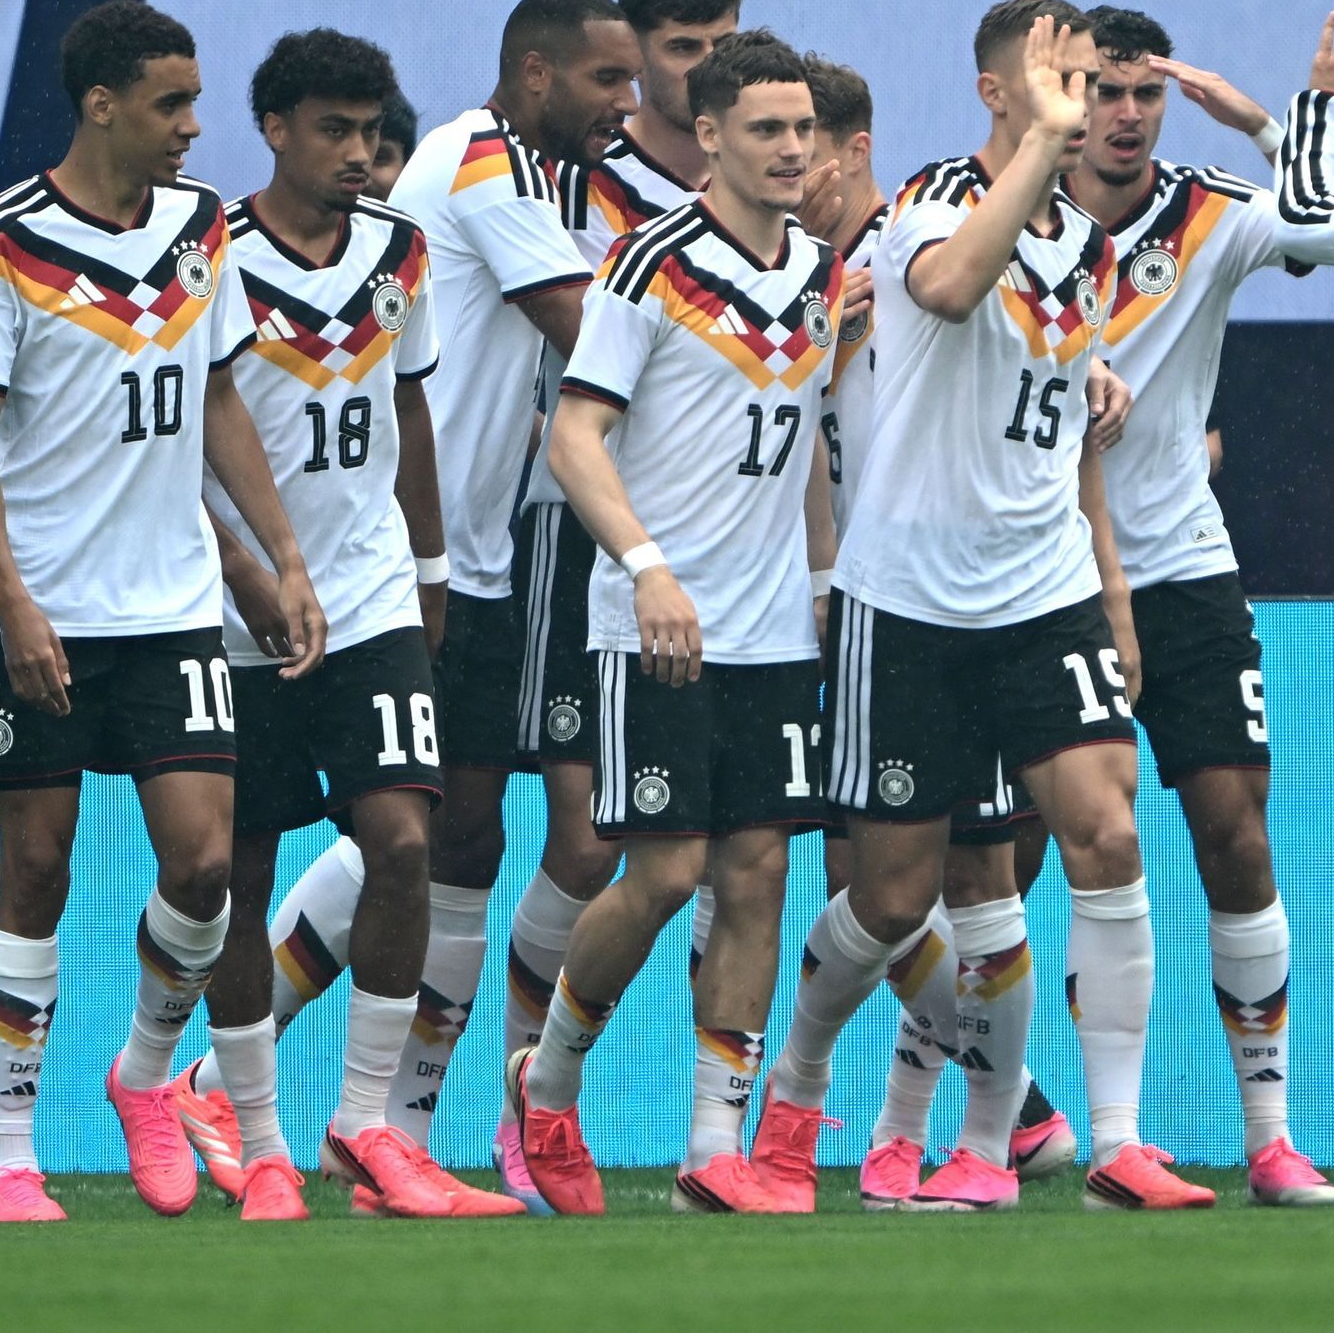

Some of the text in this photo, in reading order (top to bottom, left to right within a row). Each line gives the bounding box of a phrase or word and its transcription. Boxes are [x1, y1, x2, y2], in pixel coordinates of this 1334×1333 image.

[120, 363, 184, 444] 10
[303, 395, 372, 474] 18
[737, 402, 802, 478] 17
[1003, 368, 1070, 451] 15
[179, 656, 235, 733] 10
[371, 691, 441, 768] 18
[729, 1075, 755, 1092] DF
[1242, 1046, 1279, 1058] DFB
